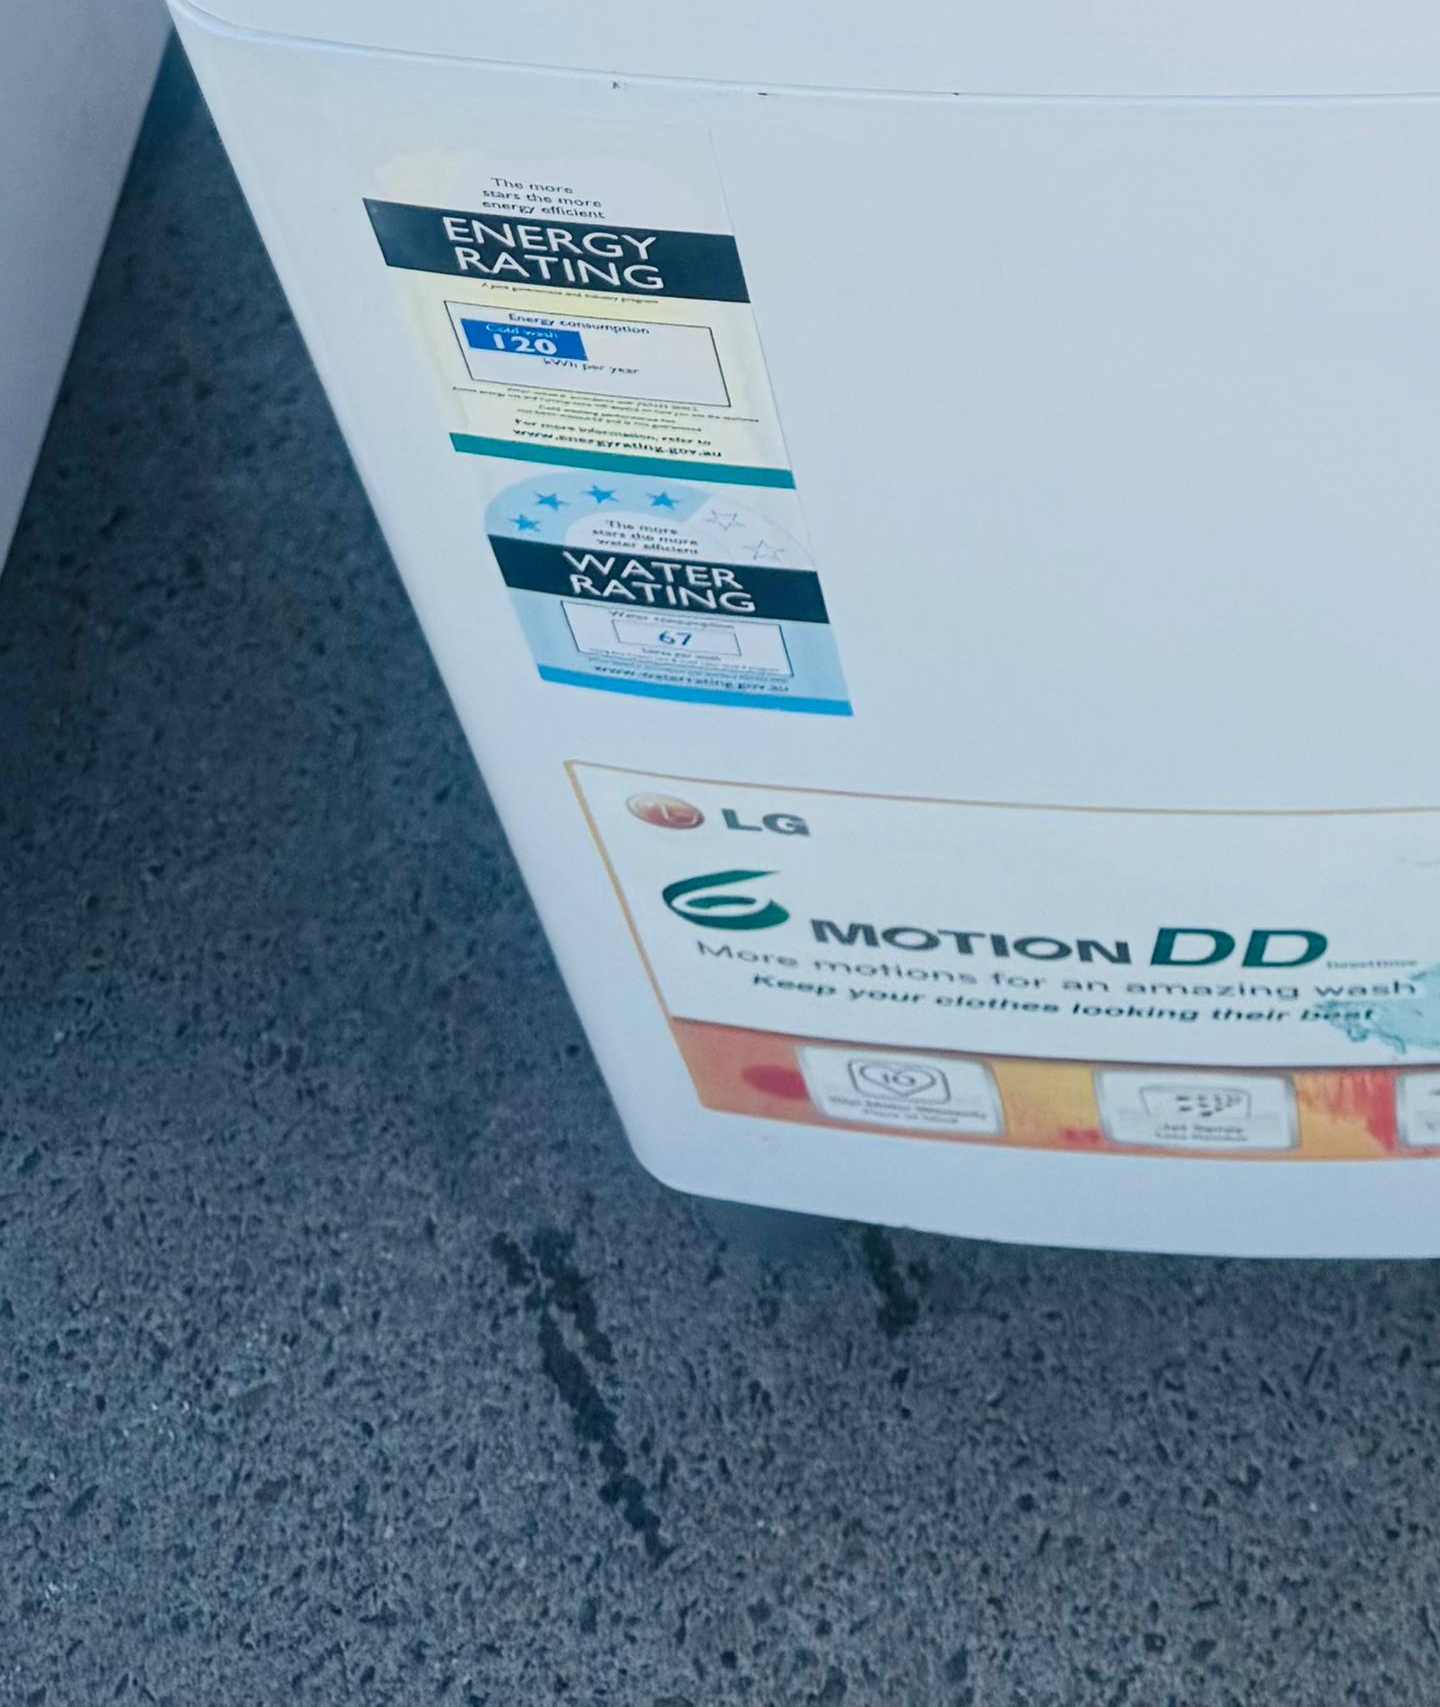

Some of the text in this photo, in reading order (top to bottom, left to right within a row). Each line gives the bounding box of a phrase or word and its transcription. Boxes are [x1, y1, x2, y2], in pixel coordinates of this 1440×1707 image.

[482, 189, 603, 208] stars the more
[491, 177, 574, 194] The more
[481, 200, 607, 220] energy efficient
[441, 216, 657, 261] ENERGY
[454, 246, 665, 290] RATING
[508, 312, 650, 335] Energy consumption
[493, 334, 558, 356] 120
[609, 365, 640, 375] year
[562, 550, 743, 590] WATER
[570, 574, 756, 613] RATING
[658, 631, 692, 647] 67
[721, 808, 810, 836] LG
[810, 918, 1132, 966] MOTION
[1150, 927, 1328, 968] DD
[697, 940, 1417, 999] More motions for an amazing wash
[753, 974, 1374, 1022] Keep your clothes looking their best
